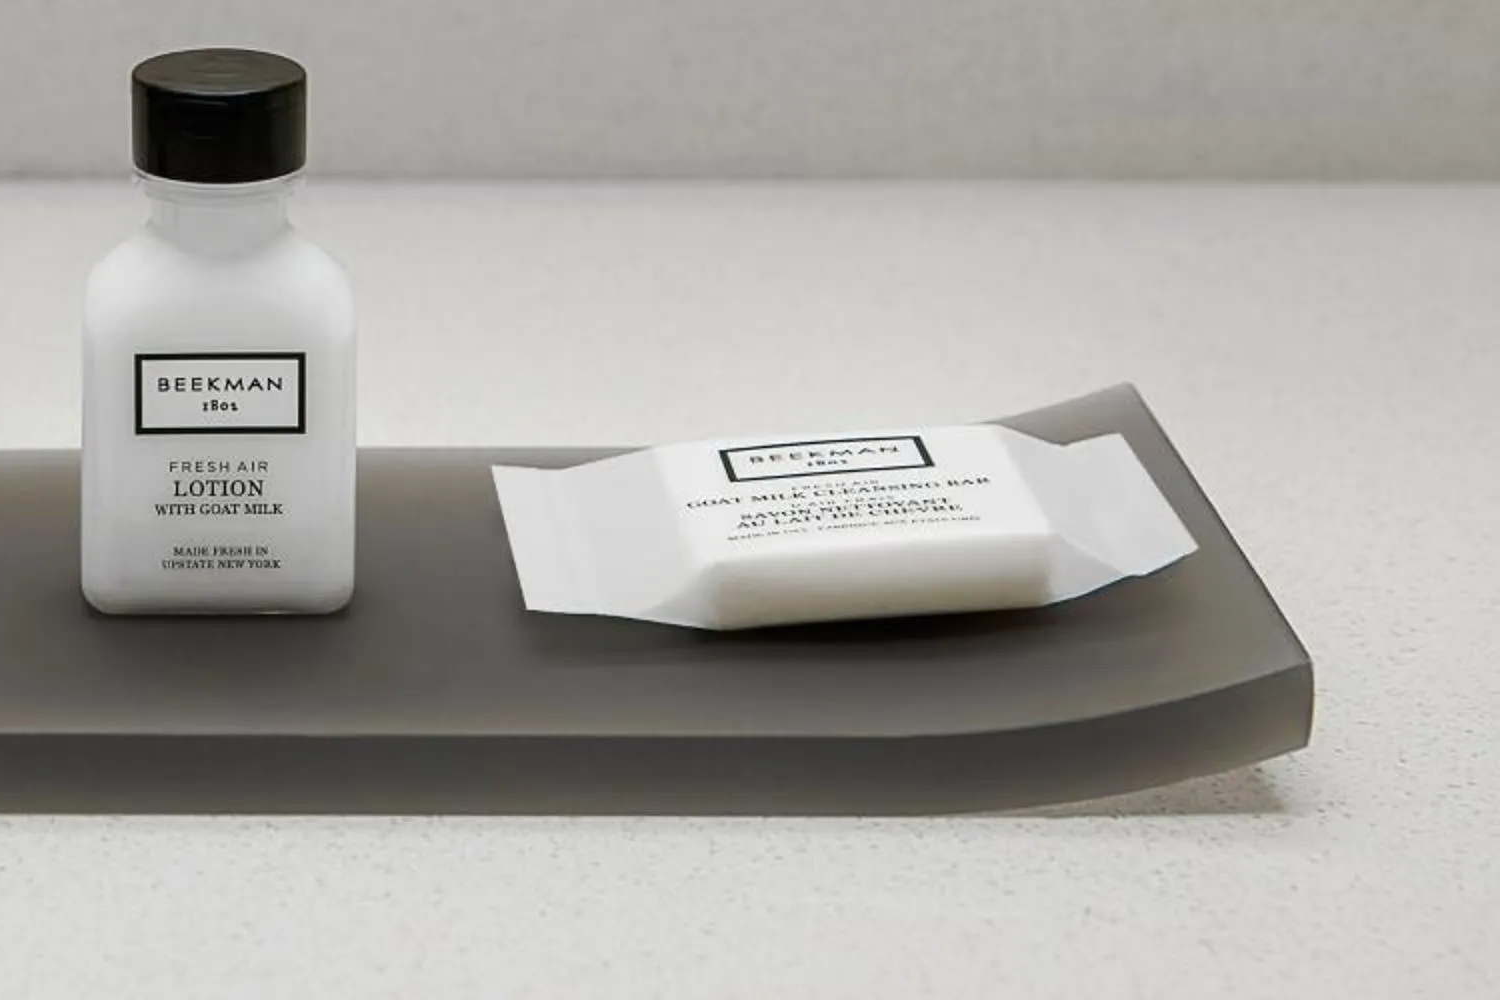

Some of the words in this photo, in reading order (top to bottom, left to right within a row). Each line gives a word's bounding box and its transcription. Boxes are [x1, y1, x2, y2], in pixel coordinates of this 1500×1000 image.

[156, 377, 284, 393] BEEKMAN
[749, 446, 899, 464] BEEKMAN
[169, 461, 230, 473] FRESH
[237, 461, 269, 473] AIR
[173, 480, 264, 498] LOTION
[751, 493, 806, 502] MILK
[155, 503, 196, 516] WITH
[199, 503, 240, 515] GOAT
[244, 503, 283, 515] MILK
[173, 546, 210, 557] MADE
[213, 546, 252, 557] FRESH
[255, 546, 269, 556] IN
[161, 559, 215, 570] UPSTATE
[217, 559, 245, 569] NEW
[248, 559, 282, 569] YORK
